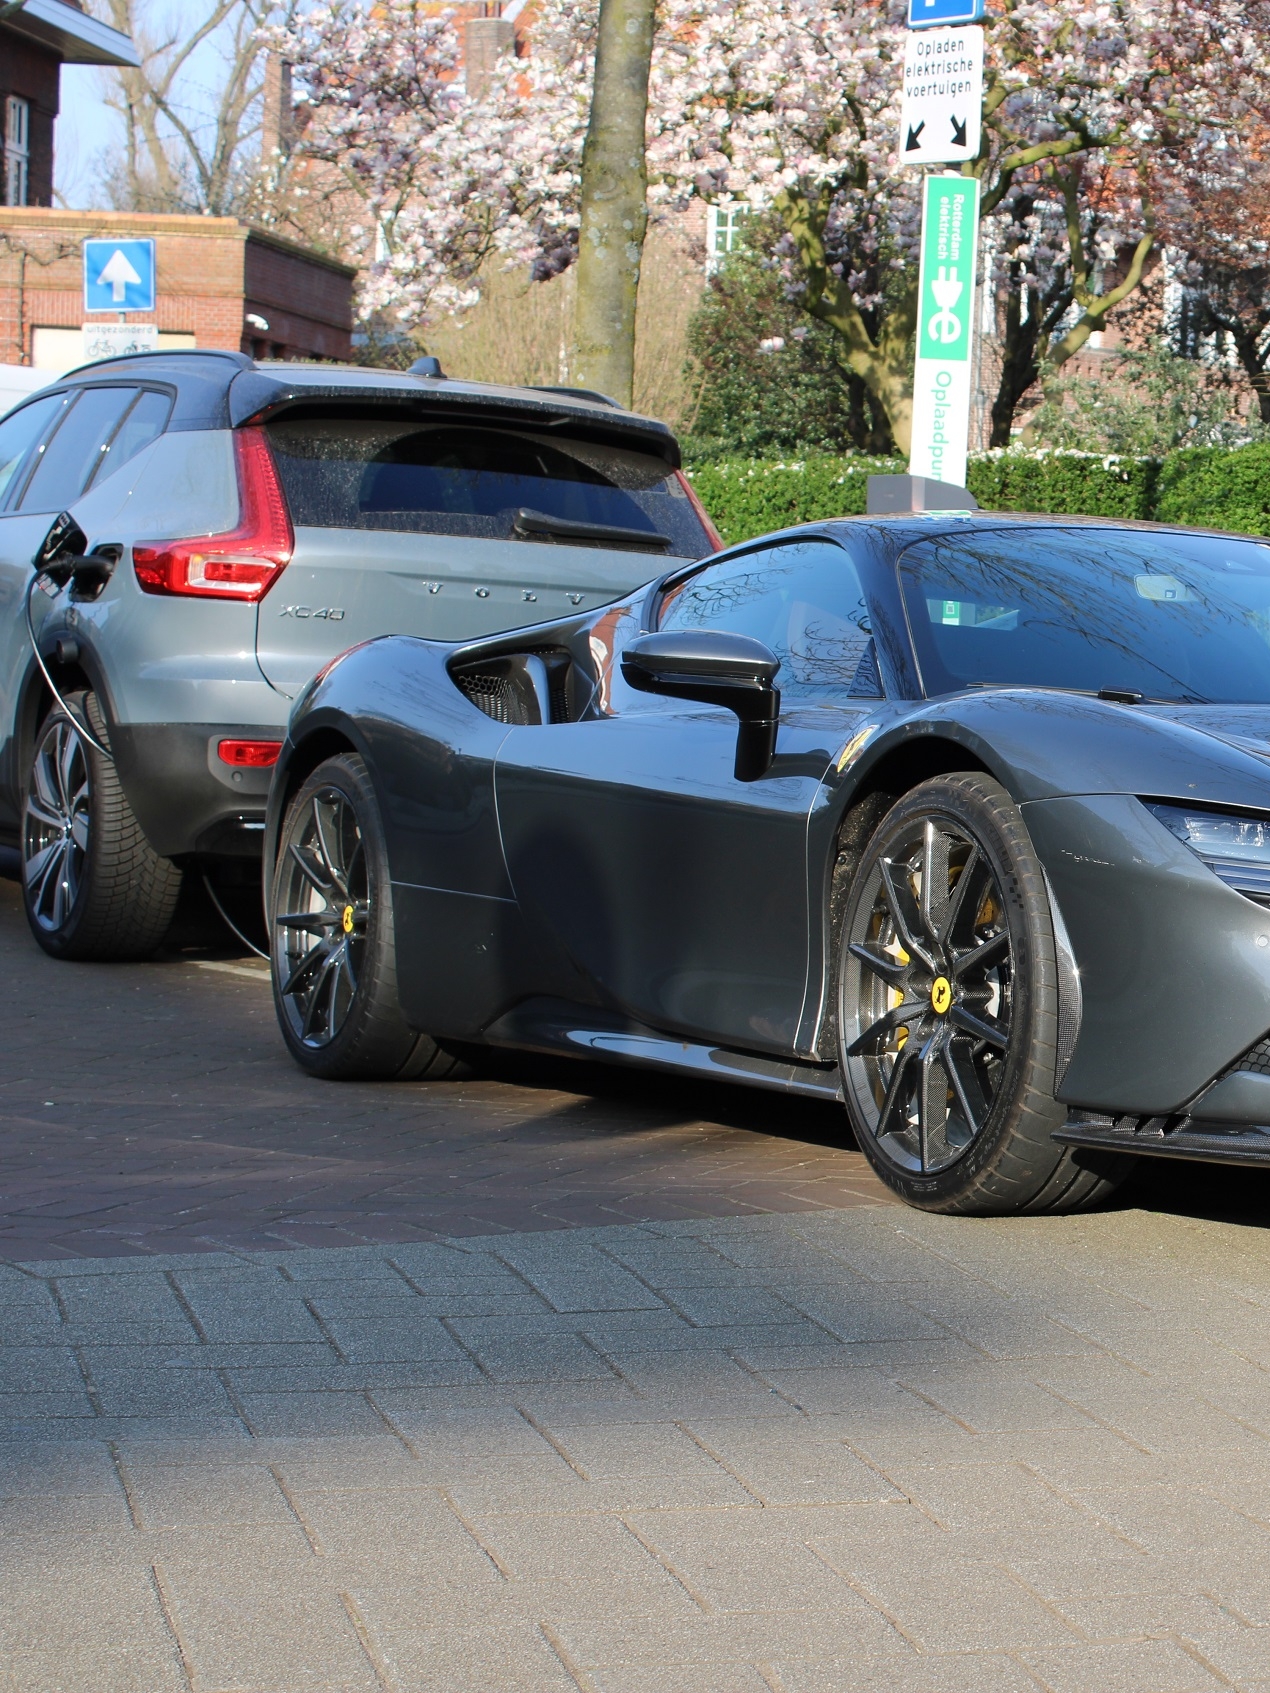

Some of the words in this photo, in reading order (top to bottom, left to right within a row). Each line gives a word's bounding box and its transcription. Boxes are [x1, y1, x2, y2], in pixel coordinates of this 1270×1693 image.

[917, 37, 965, 58] Opladen
[905, 57, 973, 77] elektrische
[906, 79, 972, 98] voertuigen
[937, 195, 952, 260] elektrisch
[949, 193, 965, 261] Rotterdam
[86, 325, 153, 336] uitgezonderd
[279, 604, 345, 621] XC40
